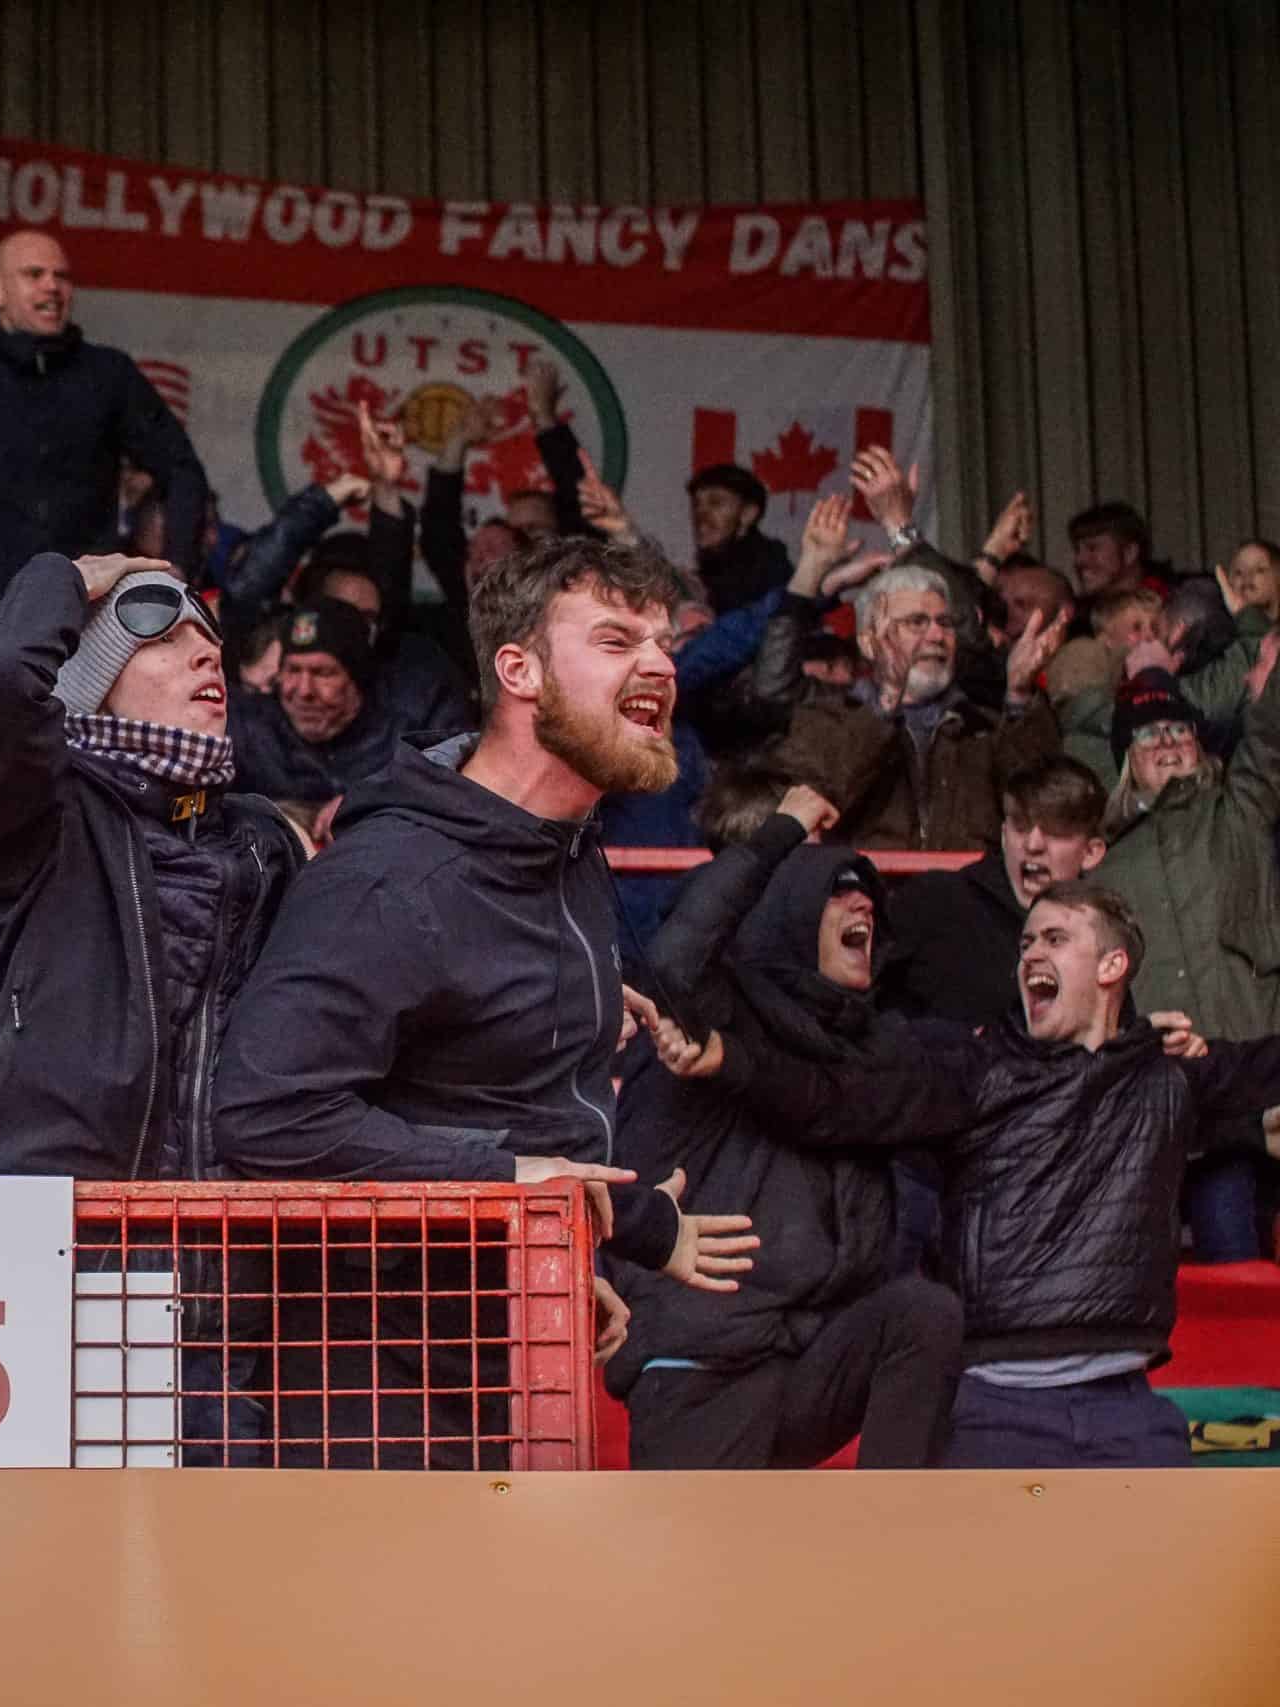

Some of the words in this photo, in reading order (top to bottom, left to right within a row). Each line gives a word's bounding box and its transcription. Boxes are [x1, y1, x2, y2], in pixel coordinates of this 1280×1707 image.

[439, 201, 701, 272] FANCY
[729, 214, 927, 281] DANS
[351, 333, 539, 375] UTST
